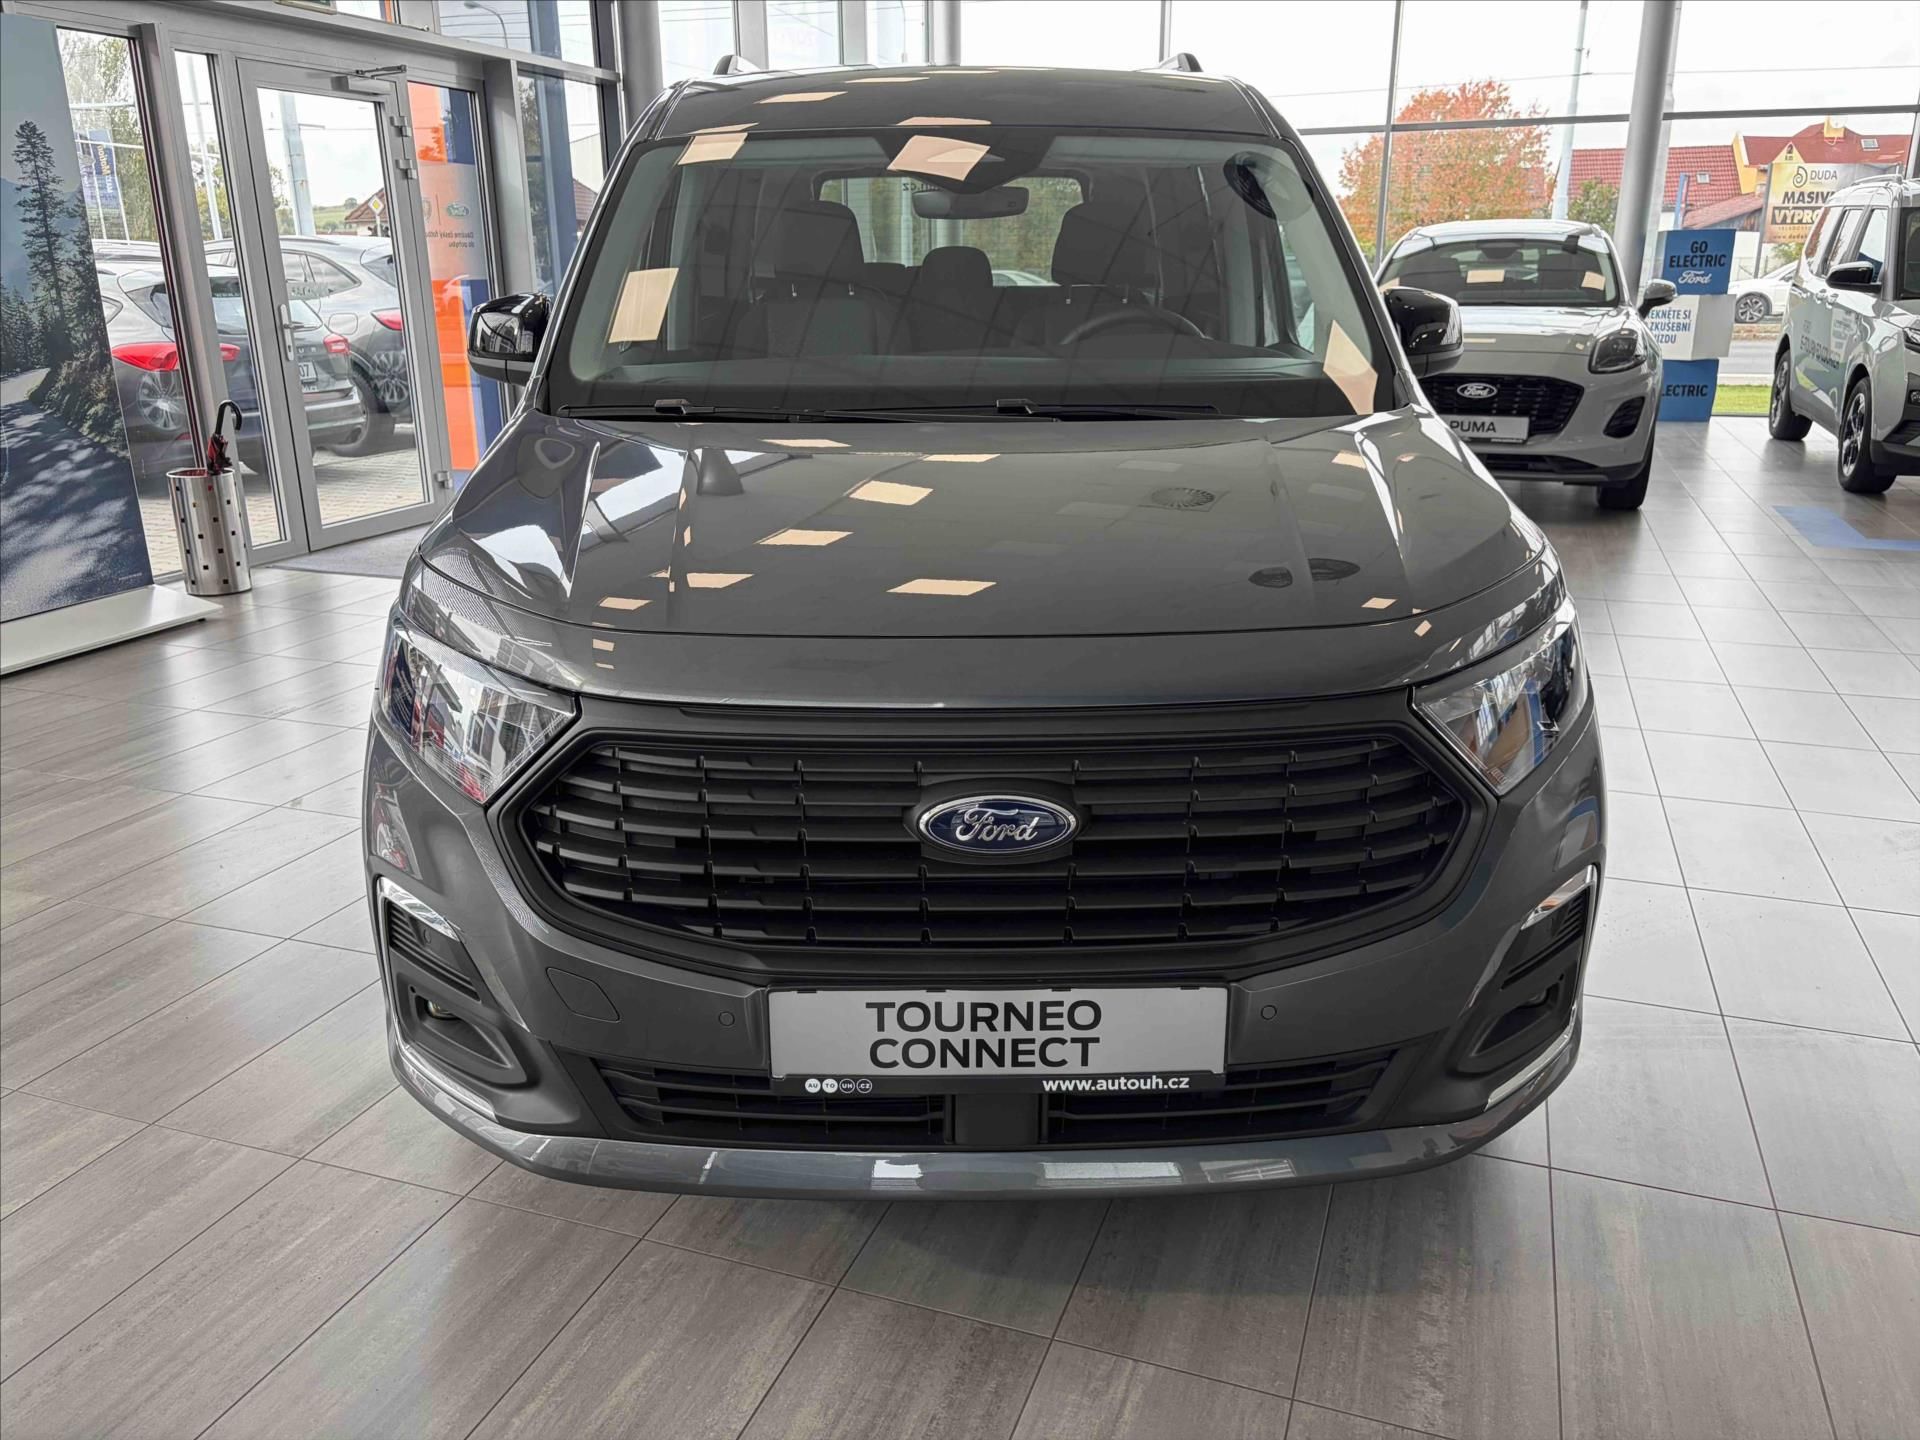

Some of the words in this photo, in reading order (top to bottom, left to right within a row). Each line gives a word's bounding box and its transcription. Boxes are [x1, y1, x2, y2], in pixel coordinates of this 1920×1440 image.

[1810, 169, 1838, 180] DUDA
[1690, 240, 1708, 254] GO
[1669, 254, 1727, 268] ELECTRIC
[1678, 270, 1712, 284] Ford
[1648, 307, 1682, 320] EKNĚTE
[1683, 309, 1691, 320] SI
[1662, 384, 1709, 397] ECTRIC
[1450, 420, 1496, 433] PUMA
[956, 804, 1040, 841] Ford
[866, 1000, 1102, 1032] TOURNEO
[869, 1037, 1100, 1068] CONNECT
[1042, 1075, 1190, 1091] www.autouh.cz
